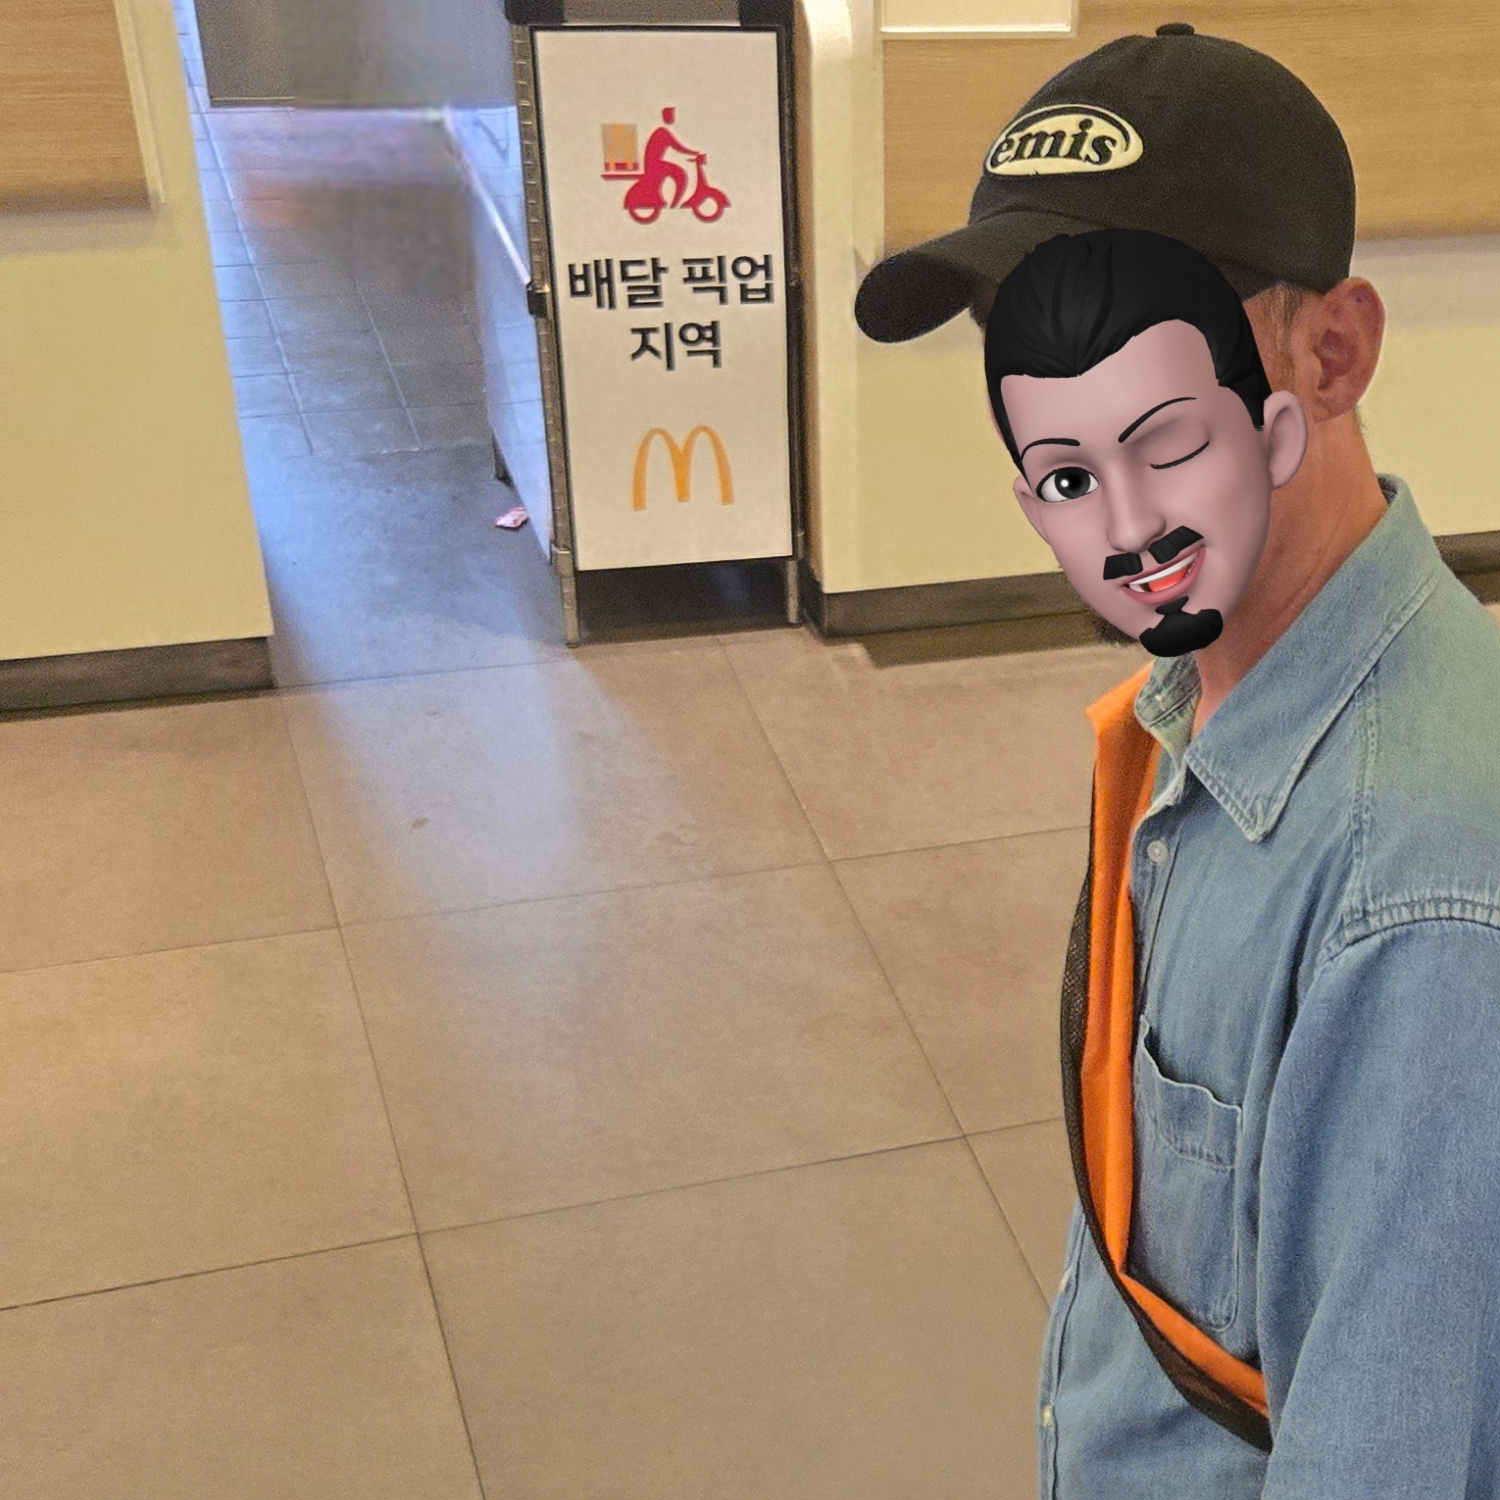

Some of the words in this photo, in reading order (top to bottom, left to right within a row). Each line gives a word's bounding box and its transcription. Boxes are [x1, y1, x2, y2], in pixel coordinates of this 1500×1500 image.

[990, 118, 1117, 169] emis
[568, 257, 669, 310] 배달
[683, 254, 774, 306] 픽업
[631, 320, 721, 371] 지역
